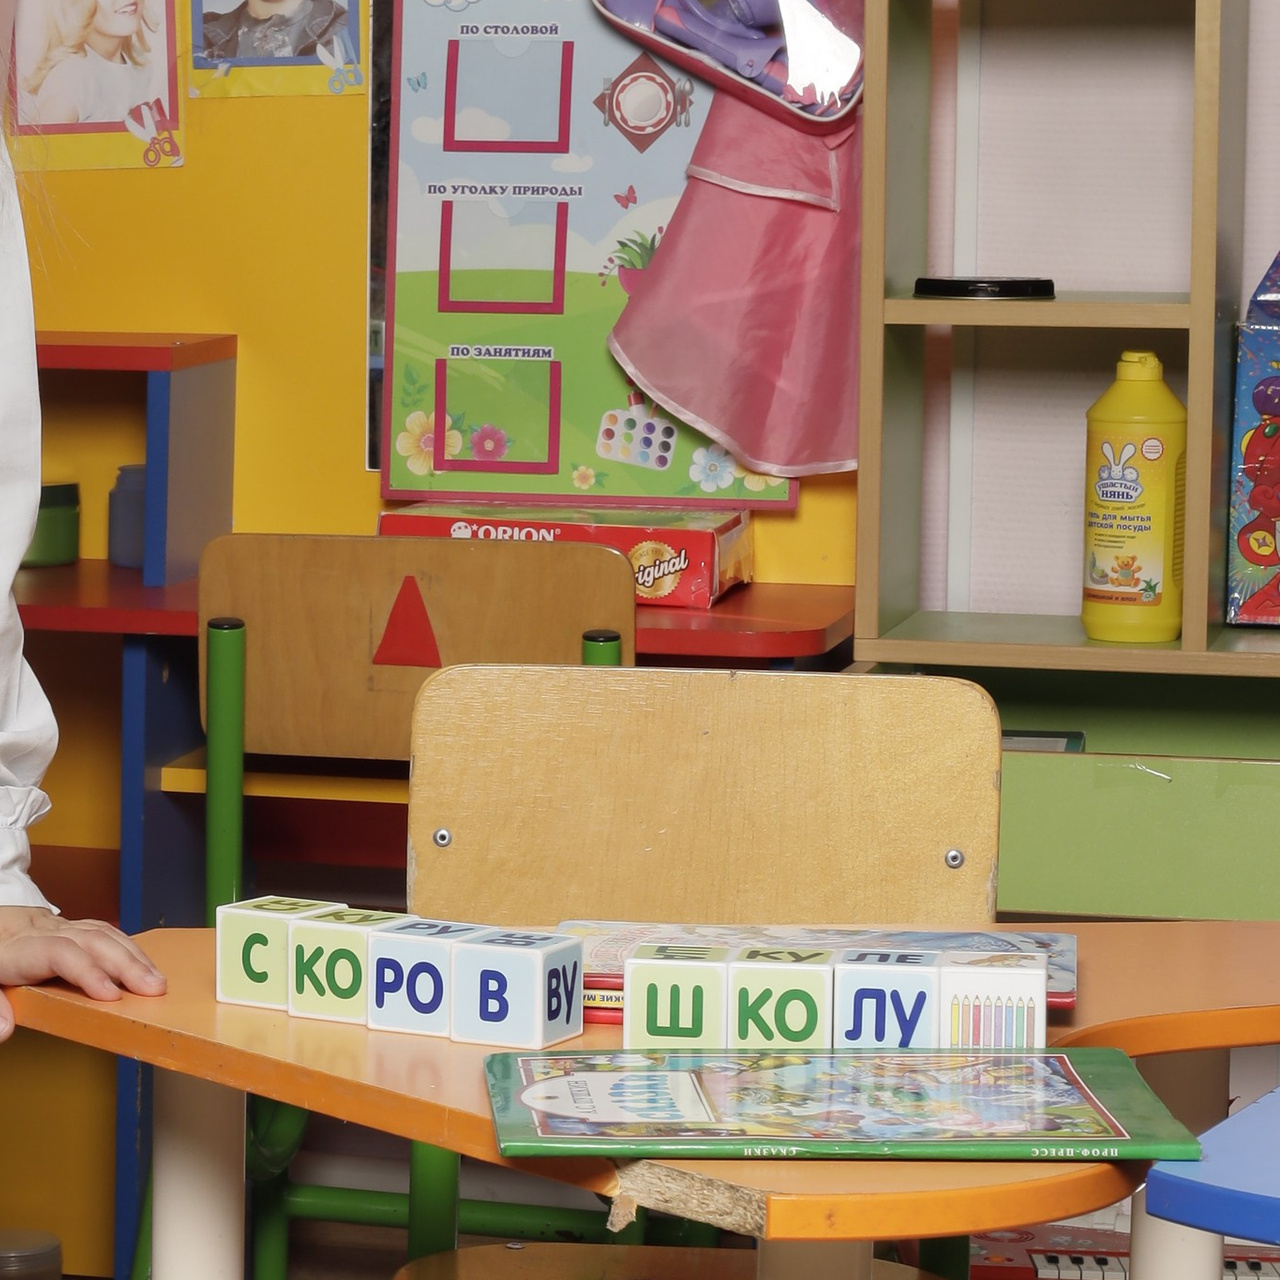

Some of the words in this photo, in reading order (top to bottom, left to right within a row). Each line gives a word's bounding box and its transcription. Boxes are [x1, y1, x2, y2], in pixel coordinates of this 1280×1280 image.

[460, 25, 480, 35] ПО
[483, 23, 559, 35] СТОЛОВОЙ
[427, 184, 447, 195] ПО
[451, 185, 509, 195] УГОЛКУ
[512, 186, 583, 197] ПРИРОДЫ
[450, 346, 470, 357] ПО
[473, 347, 552, 358] ЗАНЯТИЯМ
[477, 524, 554, 541] ORION
[743, 1146, 797, 1157] СКАЗКИ
[1030, 1146, 1119, 1157] ПРОФ-ПРЕСС
